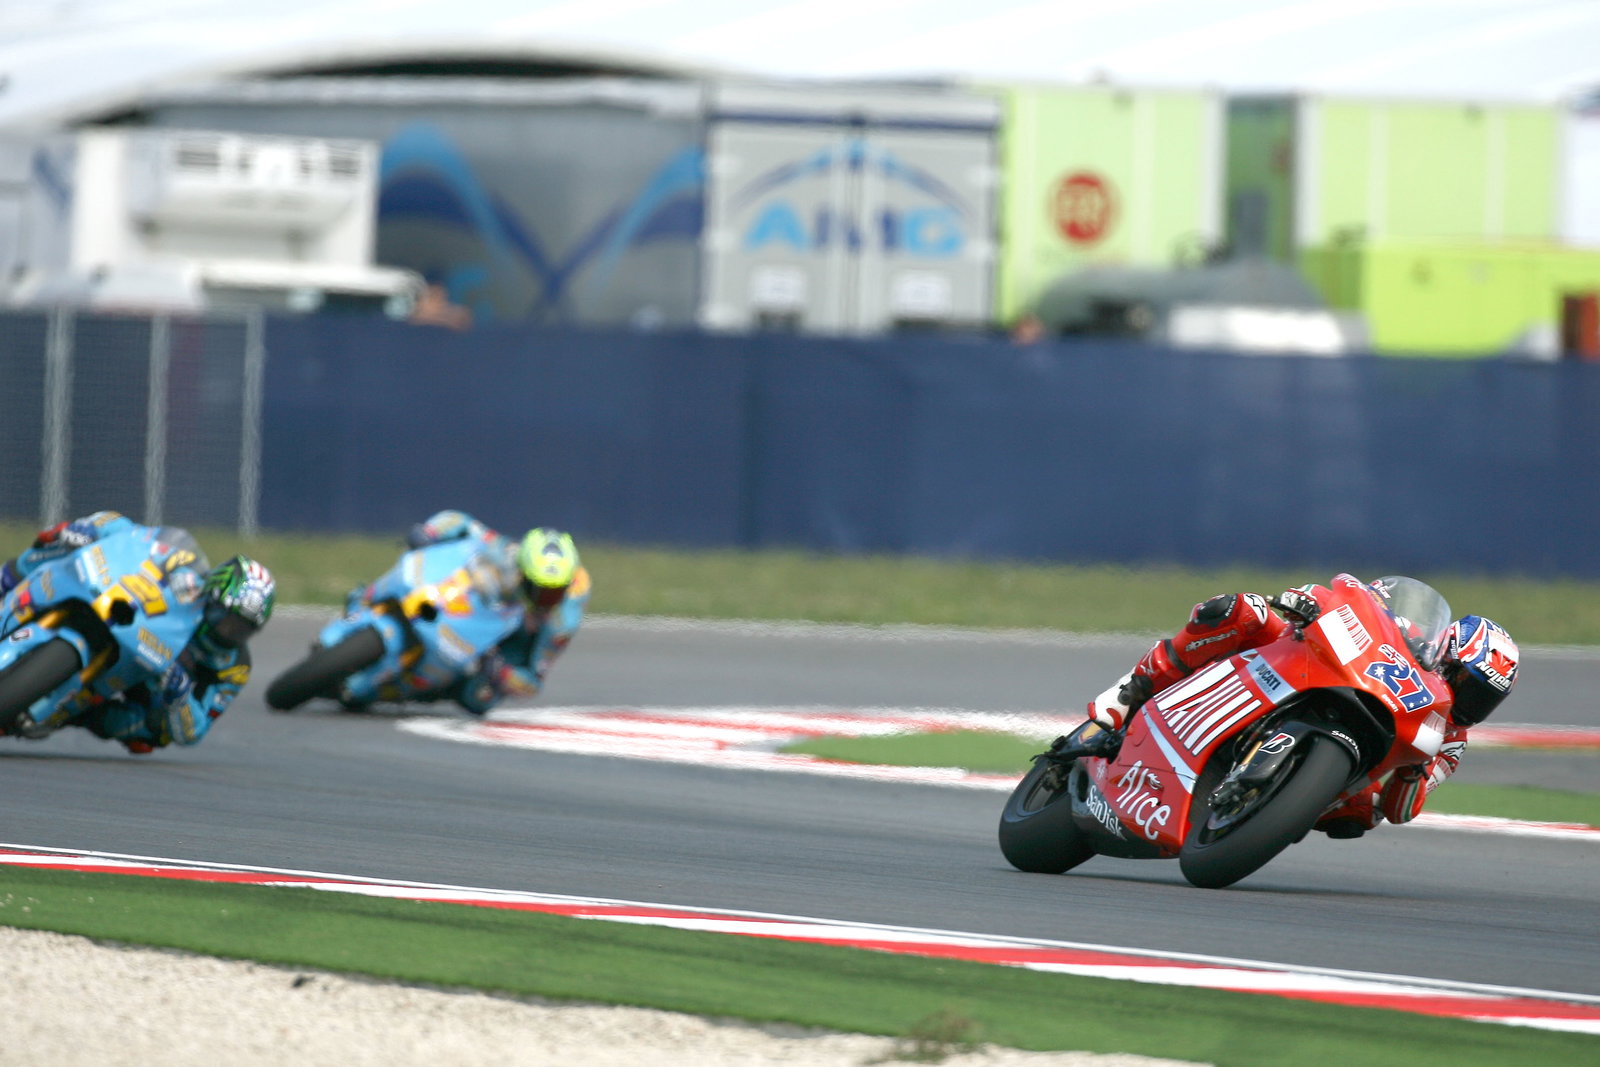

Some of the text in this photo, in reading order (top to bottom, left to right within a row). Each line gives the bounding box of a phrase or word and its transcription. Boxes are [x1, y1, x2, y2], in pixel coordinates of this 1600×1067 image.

[1255, 664, 1281, 690] DUCATI
[1363, 643, 1436, 713] 27
[1475, 661, 1513, 688] NOLAN
[1086, 785, 1128, 841] SanDisk
[1116, 760, 1171, 840] Alice
